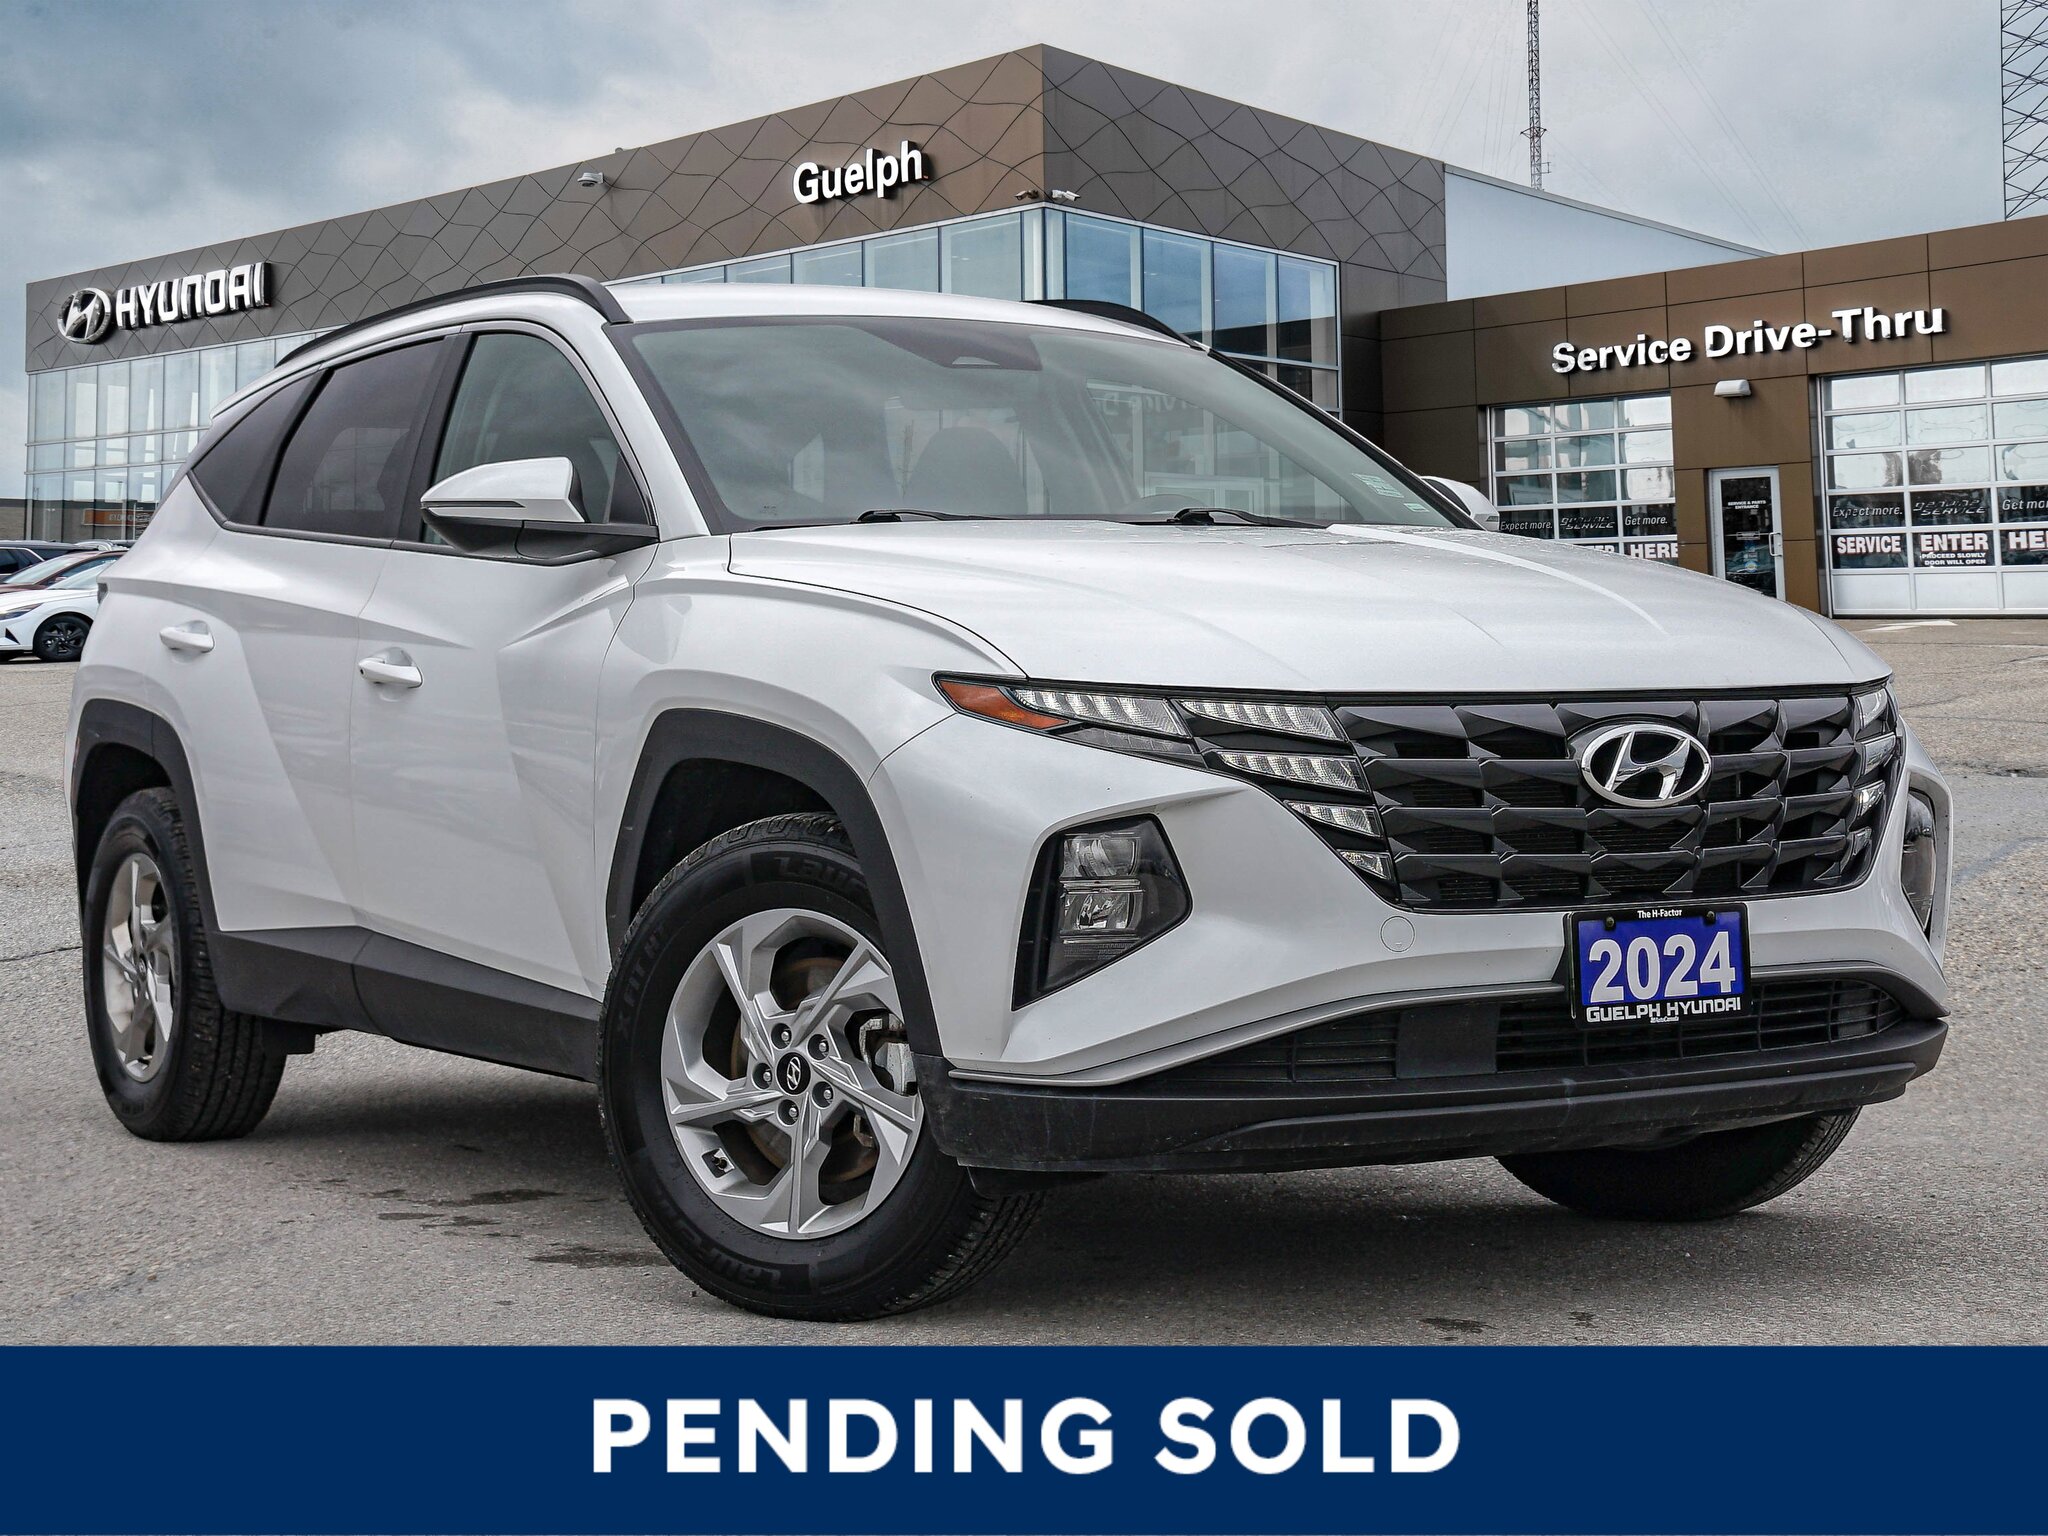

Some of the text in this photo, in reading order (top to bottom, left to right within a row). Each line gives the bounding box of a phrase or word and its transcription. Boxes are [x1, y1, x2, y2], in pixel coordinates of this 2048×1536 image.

[792, 140, 925, 204] Guelph
[115, 262, 270, 329] HYUNDAI
[1552, 307, 1945, 374] Service Drive-Thru
[1833, 506, 1903, 518] Expect more.
[1921, 507, 1986, 515] SERVICE
[2002, 500, 2024, 510] Get
[1500, 520, 1553, 532] Expect more.
[1625, 516, 1668, 526] Get more.
[1837, 535, 1902, 554] SERVICE
[1920, 533, 1989, 552] ENTER
[2008, 531, 2048, 549] HE
[1637, 909, 1682, 918] The H-Factor
[1588, 931, 1736, 1003] 2024
[1586, 997, 1741, 1023] GUELPH HYUNDAI
